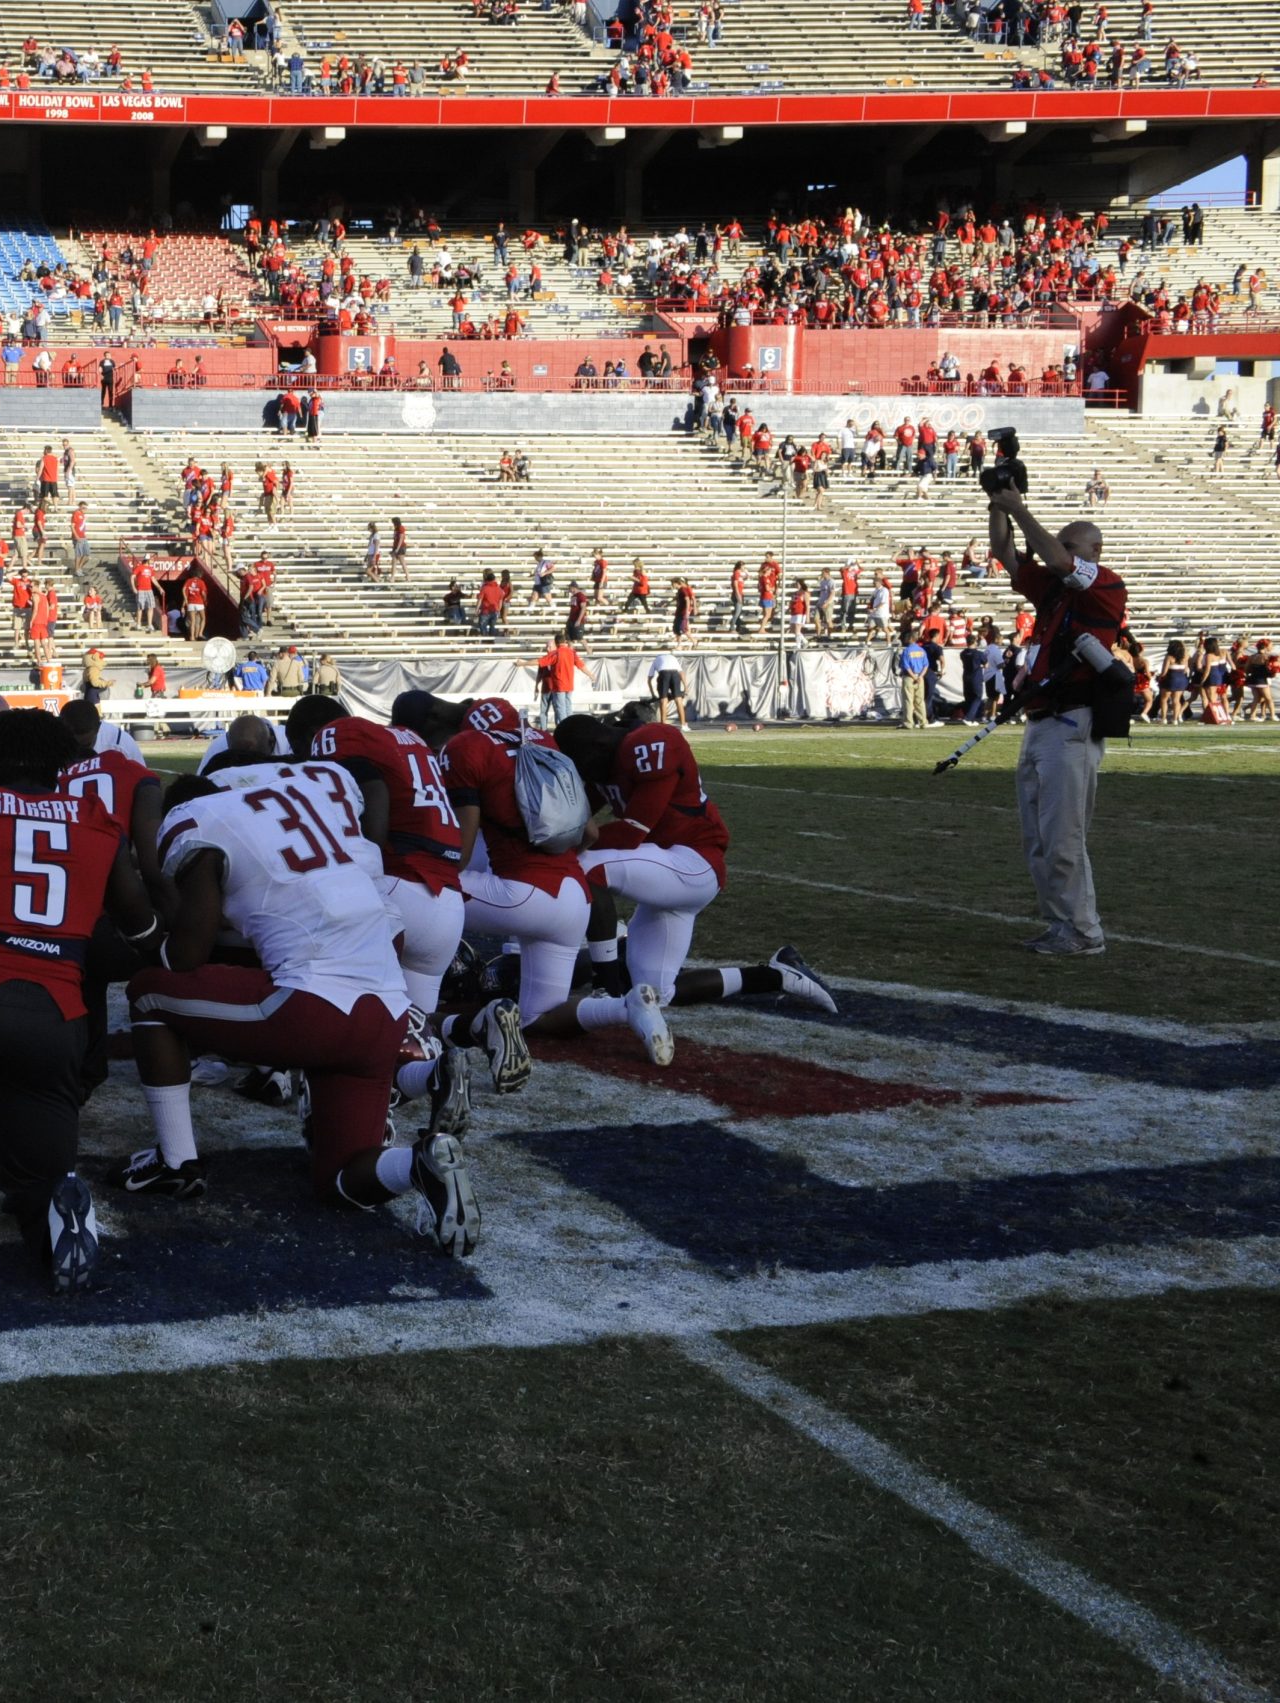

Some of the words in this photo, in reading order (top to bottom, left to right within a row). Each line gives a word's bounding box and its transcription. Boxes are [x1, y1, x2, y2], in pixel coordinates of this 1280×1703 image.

[19, 95, 63, 107] HOLIDAY
[65, 96, 95, 108] BOWL
[102, 95, 119, 107] LAS
[121, 96, 153, 108] VEGAS
[154, 96, 183, 108] BOWL
[45, 109, 68, 118] 1998
[354, 349, 365, 362] 5
[764, 349, 776, 362] 6
[177, 561, 183, 572] 5
[469, 703, 503, 730] 83
[634, 741, 666, 773] 27
[242, 785, 356, 874] 31
[14, 818, 68, 926] 5
[6, 935, 61, 956] ARIZONA
